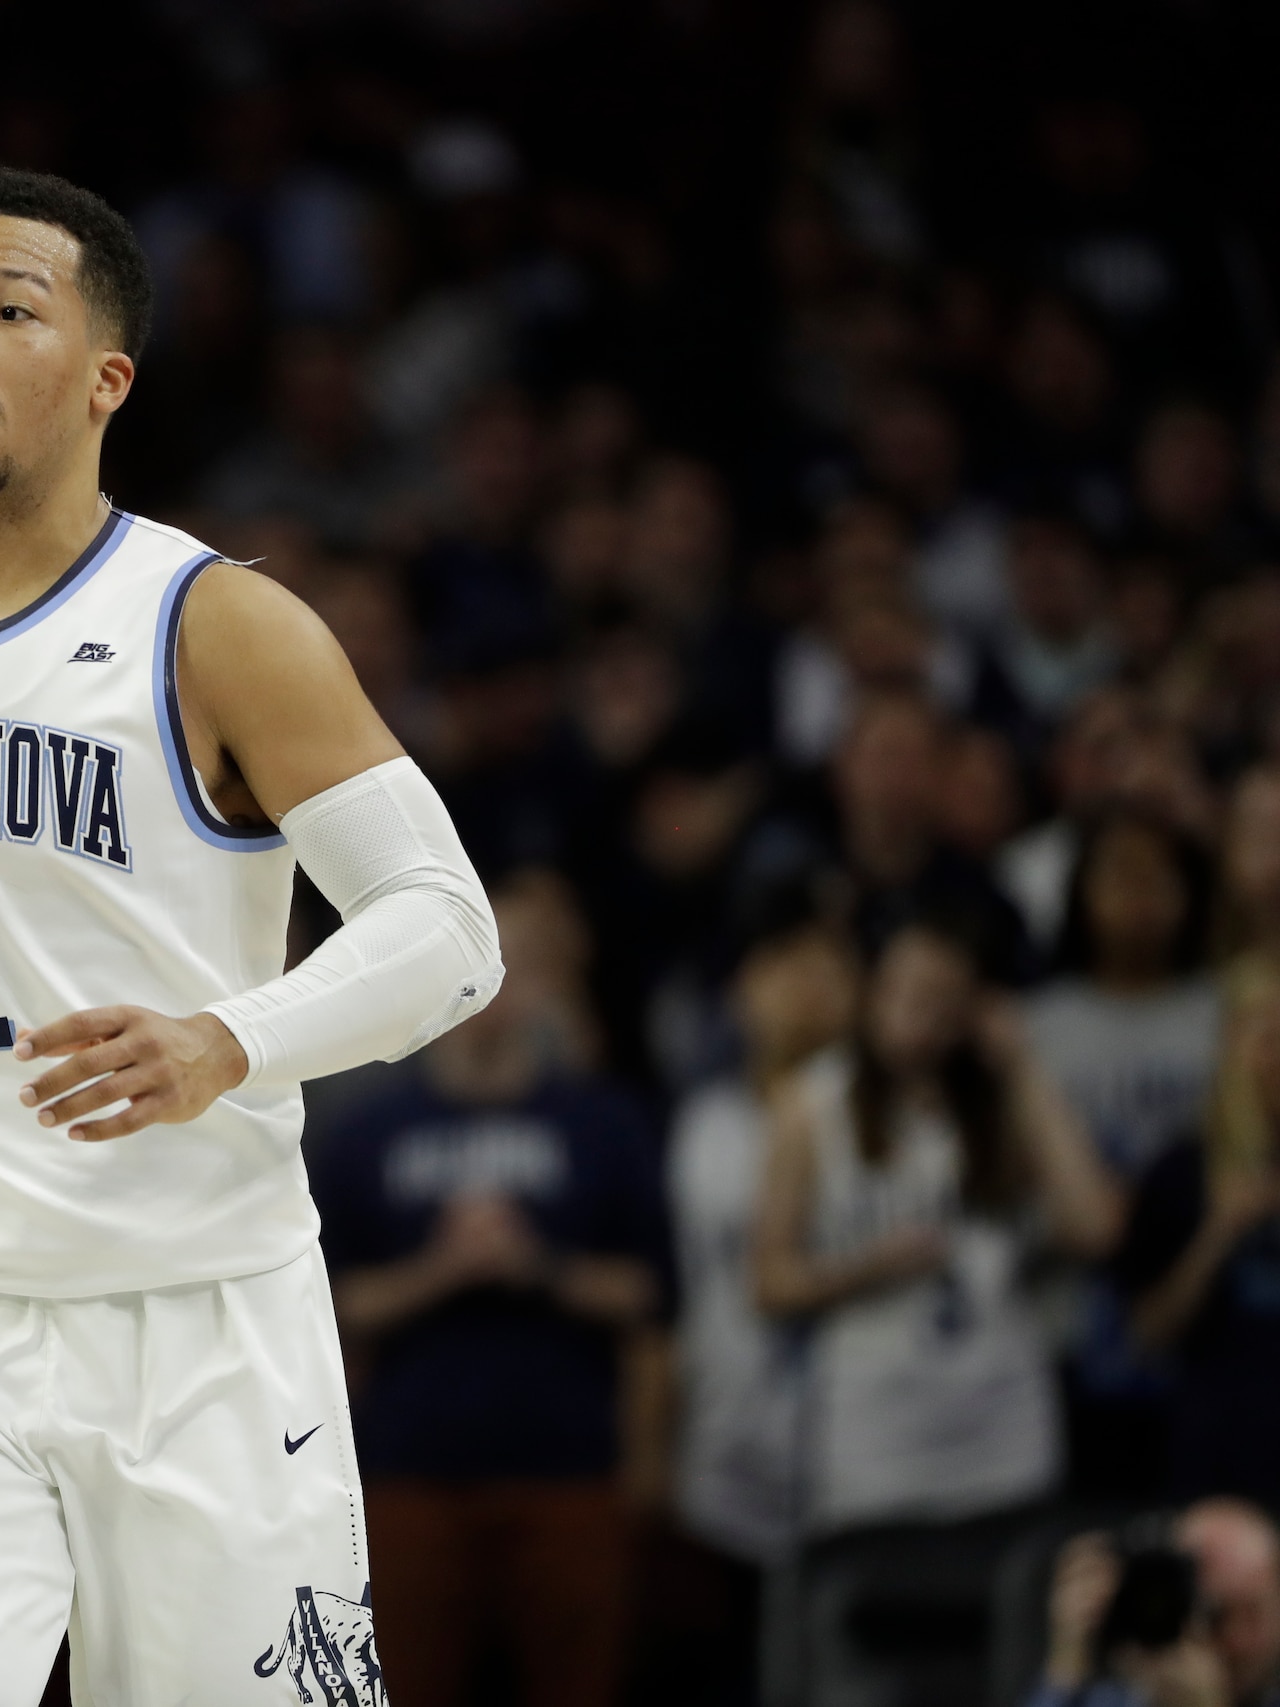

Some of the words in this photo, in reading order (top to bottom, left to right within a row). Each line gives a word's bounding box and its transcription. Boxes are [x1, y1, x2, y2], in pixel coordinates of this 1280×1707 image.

[79, 642, 111, 653] BIG
[72, 650, 117, 661] EAST
[301, 1599, 351, 1707] VILLANOVA
